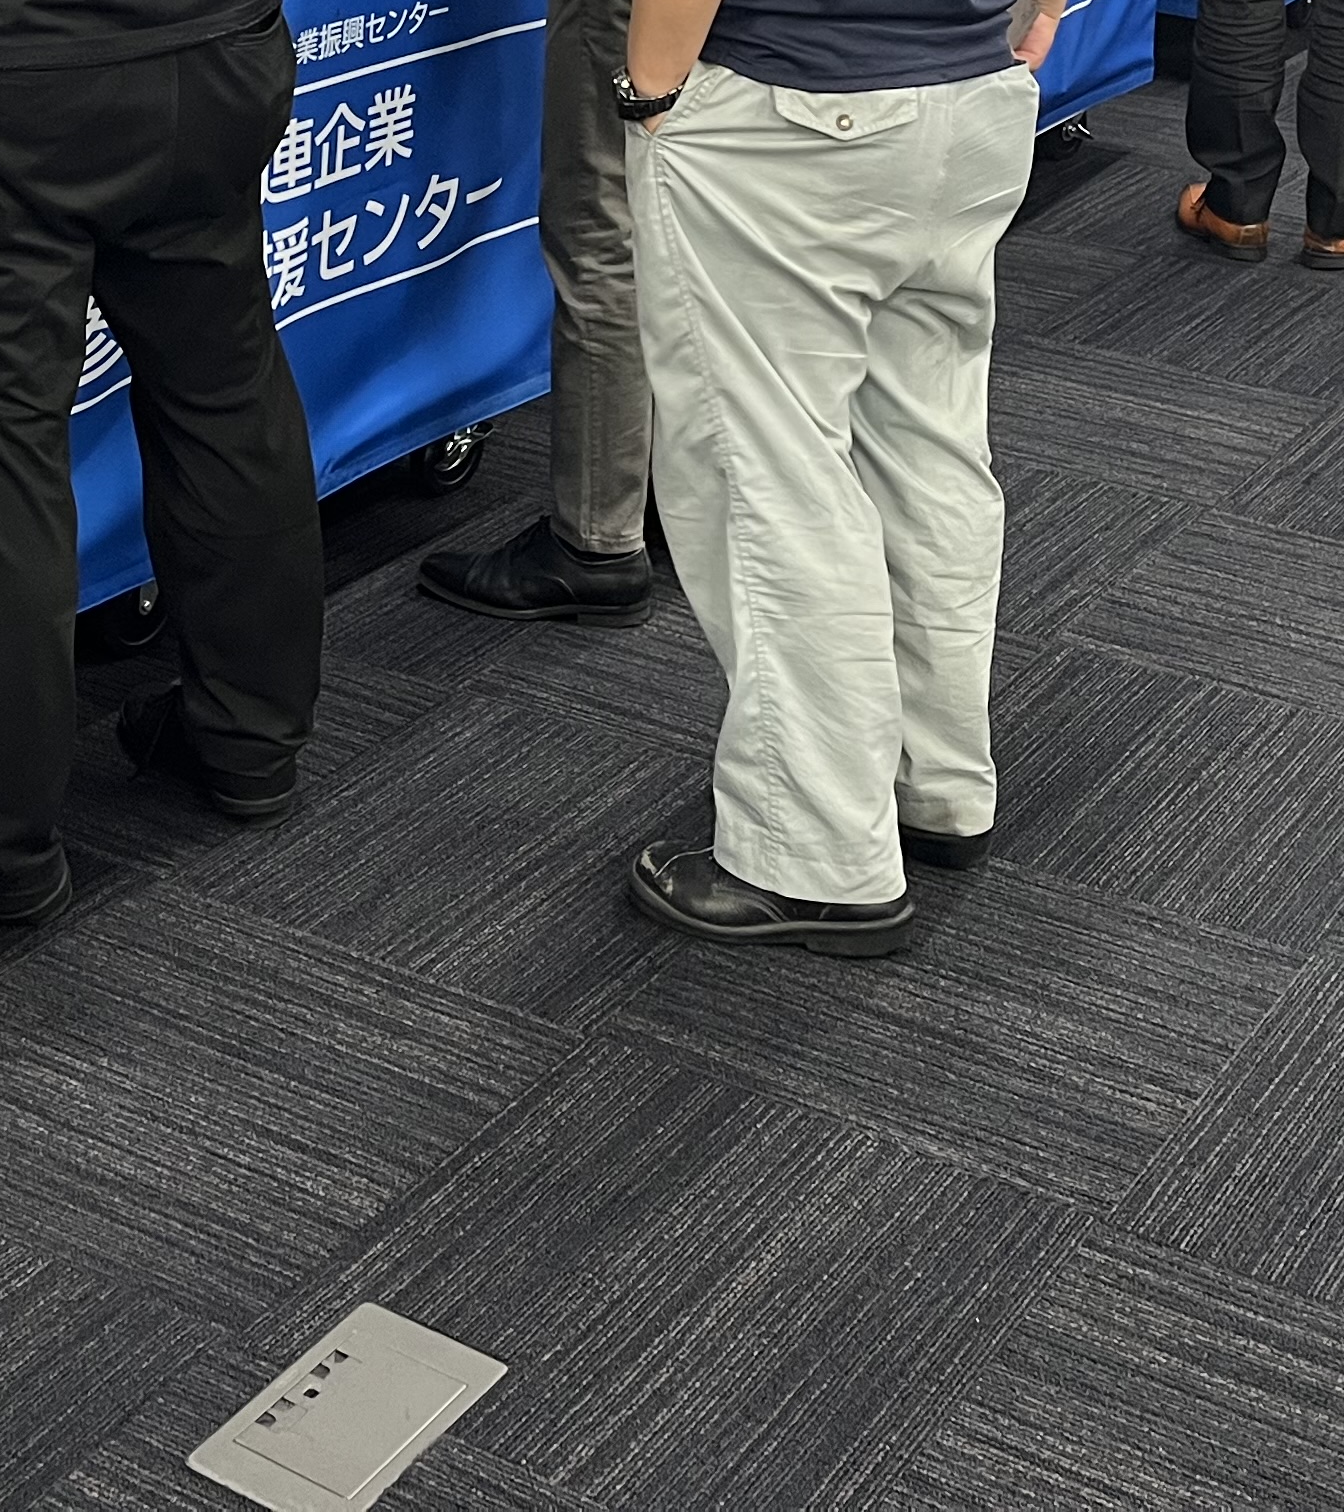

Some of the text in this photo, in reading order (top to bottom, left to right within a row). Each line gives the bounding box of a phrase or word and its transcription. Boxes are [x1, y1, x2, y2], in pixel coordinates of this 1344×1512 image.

[293, 1, 449, 65] 業振興センター
